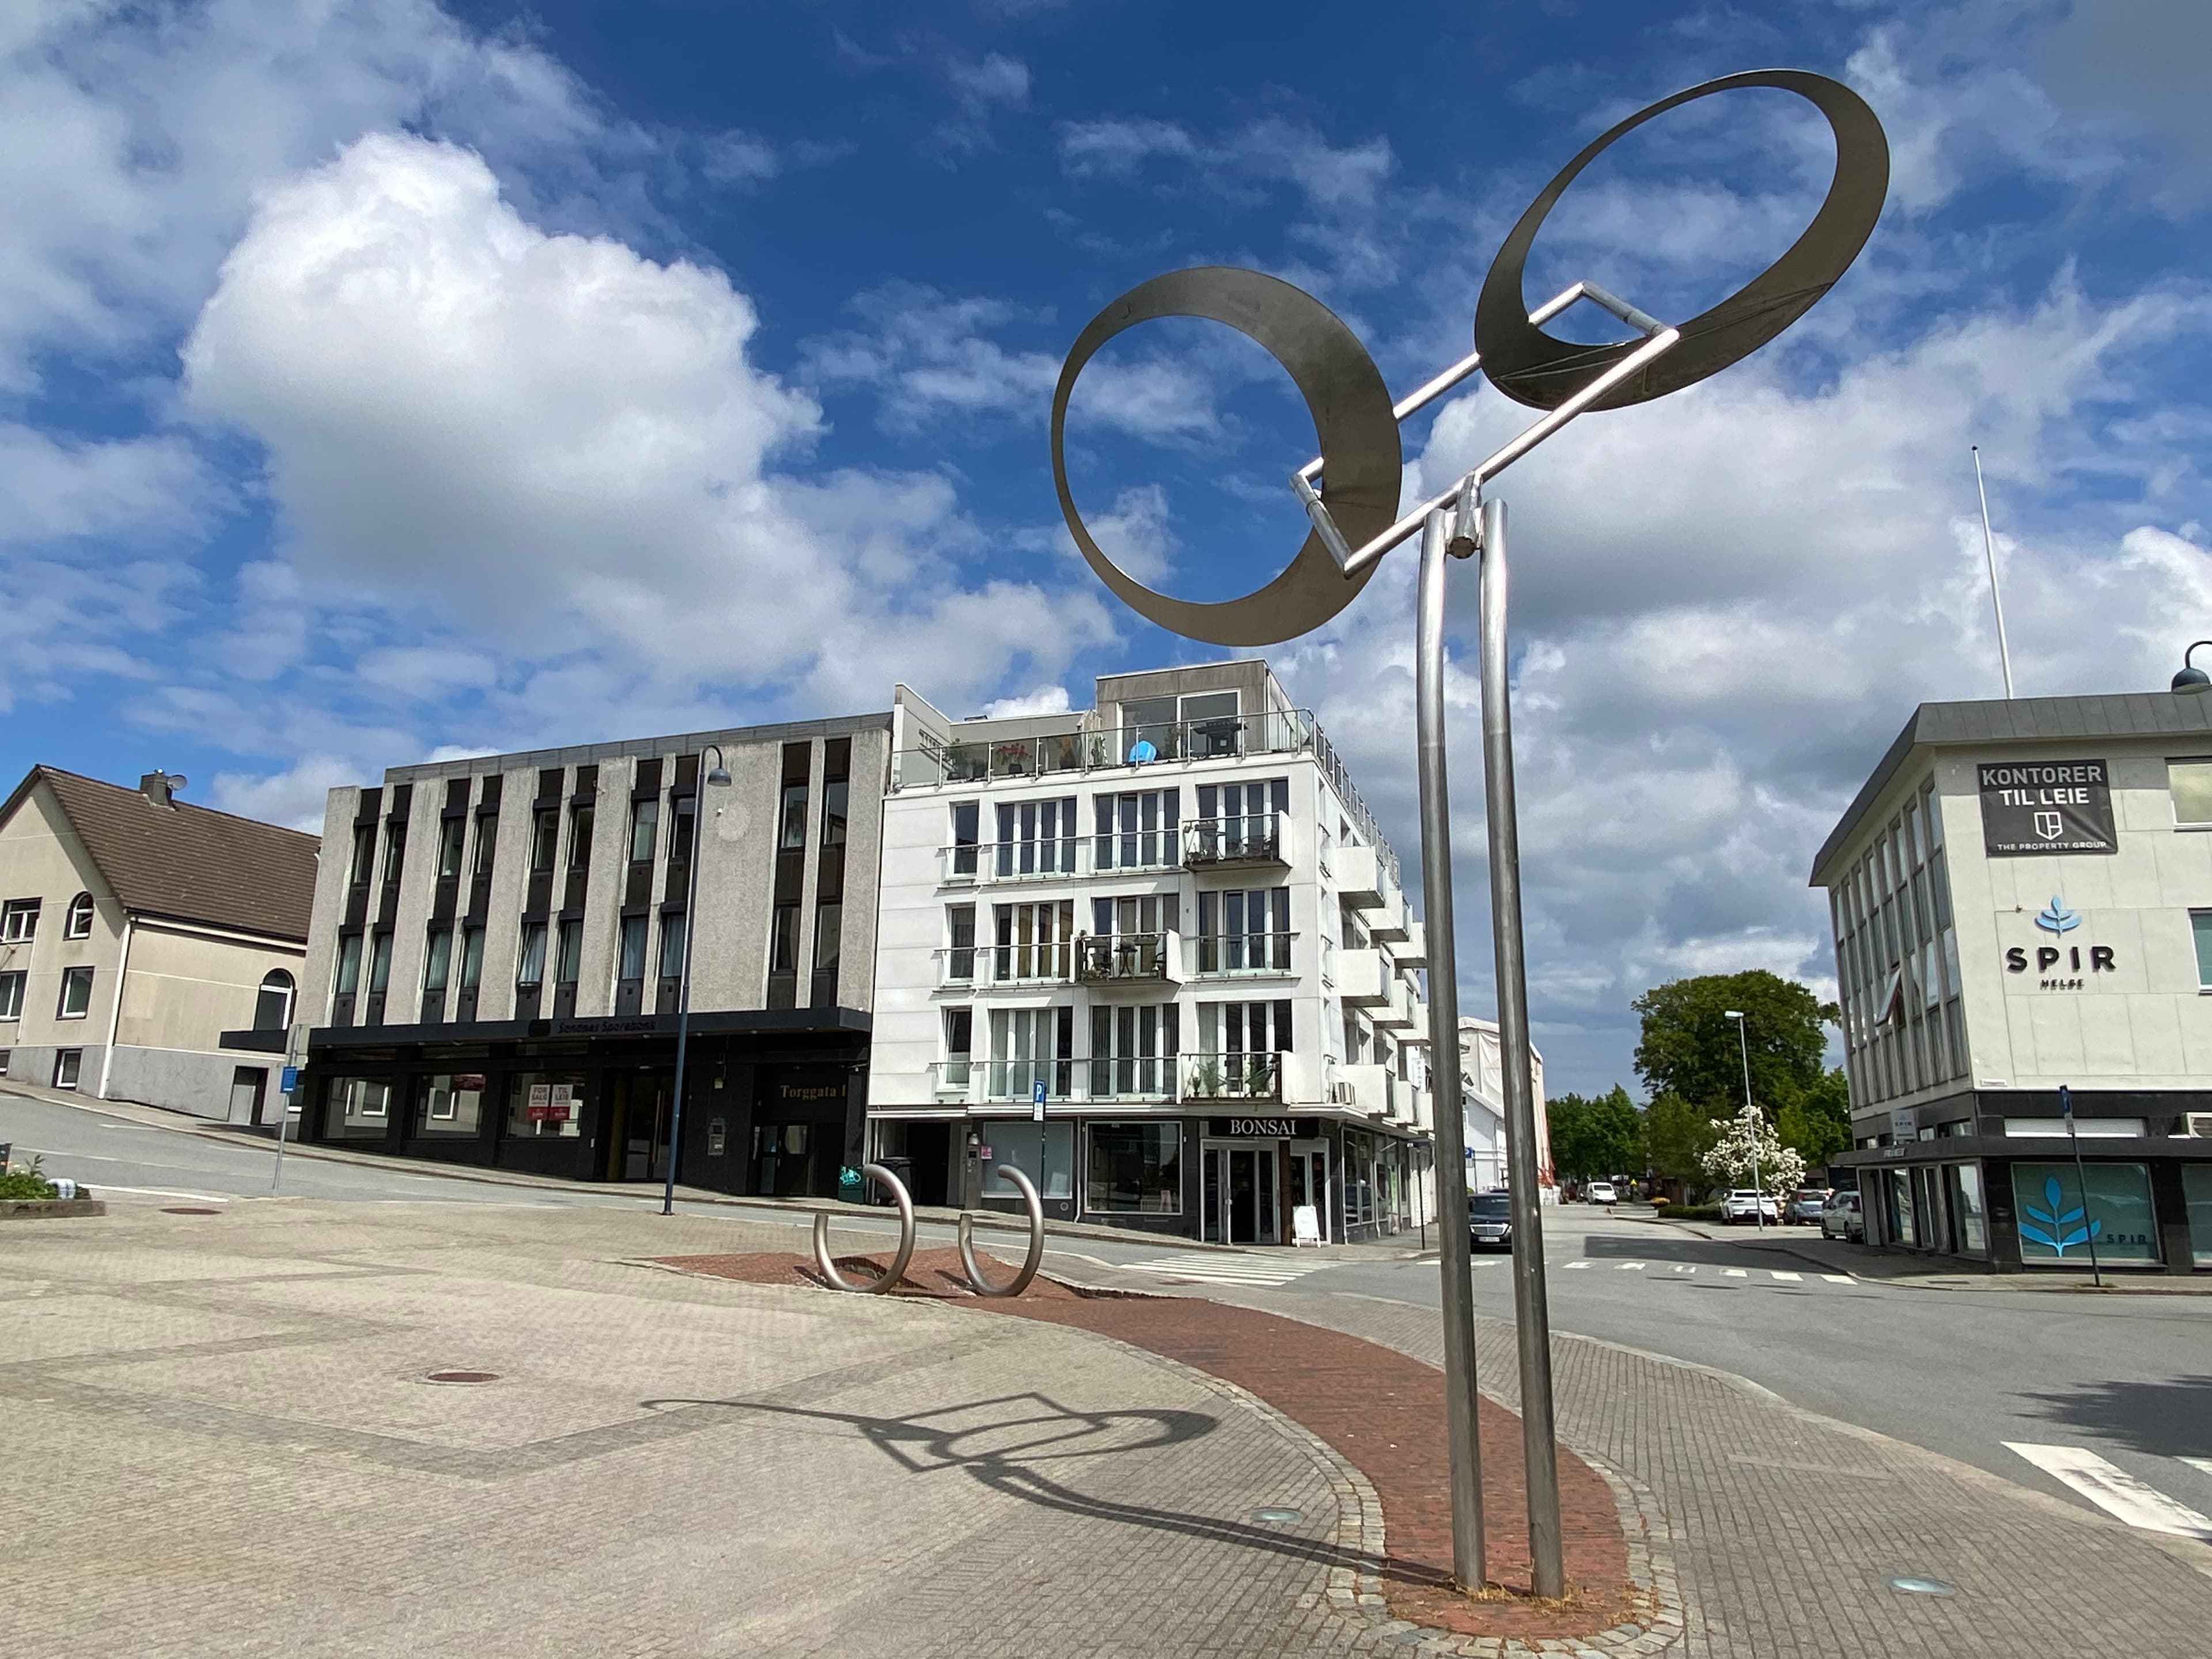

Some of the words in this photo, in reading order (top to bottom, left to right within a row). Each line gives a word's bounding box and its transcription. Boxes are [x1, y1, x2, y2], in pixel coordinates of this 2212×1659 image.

[1982, 766, 2102, 785] KONTORER
[1998, 789, 2035, 805] TIL
[2040, 788, 2089, 805] LEIE
[2019, 842, 2069, 850] PROPERTY
[2005, 946, 2116, 971] SPIR
[779, 1085, 836, 1101] Torggata
[1036, 1084, 1042, 1101] P
[1230, 1119, 1297, 1135] BONSAI
[2107, 1234, 2147, 1244] SPIR
